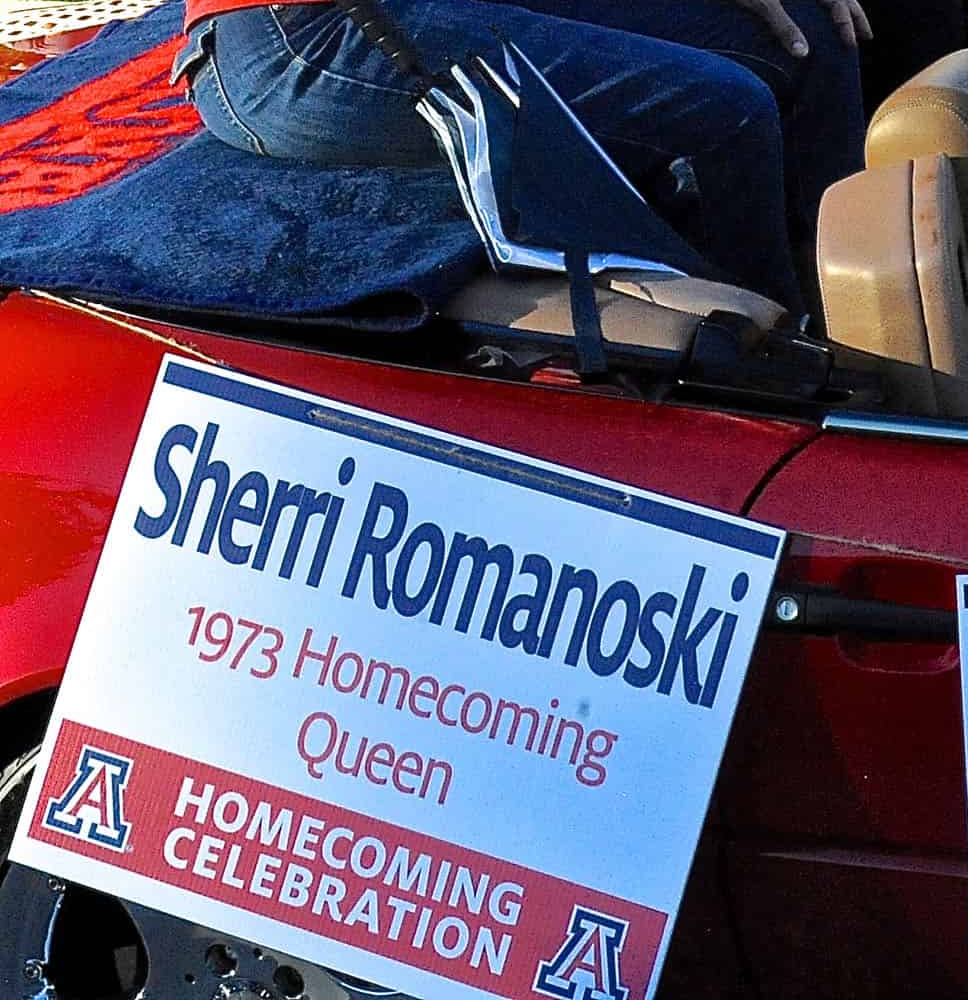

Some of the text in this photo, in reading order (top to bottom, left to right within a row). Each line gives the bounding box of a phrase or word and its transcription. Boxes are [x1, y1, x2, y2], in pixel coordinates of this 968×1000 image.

[133, 422, 749, 709] Sherri Romanoski
[187, 605, 619, 787] 1973 Homecoming
[296, 711, 453, 805] Queen
[41, 744, 134, 854] A
[173, 776, 525, 926] HOMECOMING
[163, 826, 513, 977] CELEBRATION
[531, 903, 630, 1000] A
